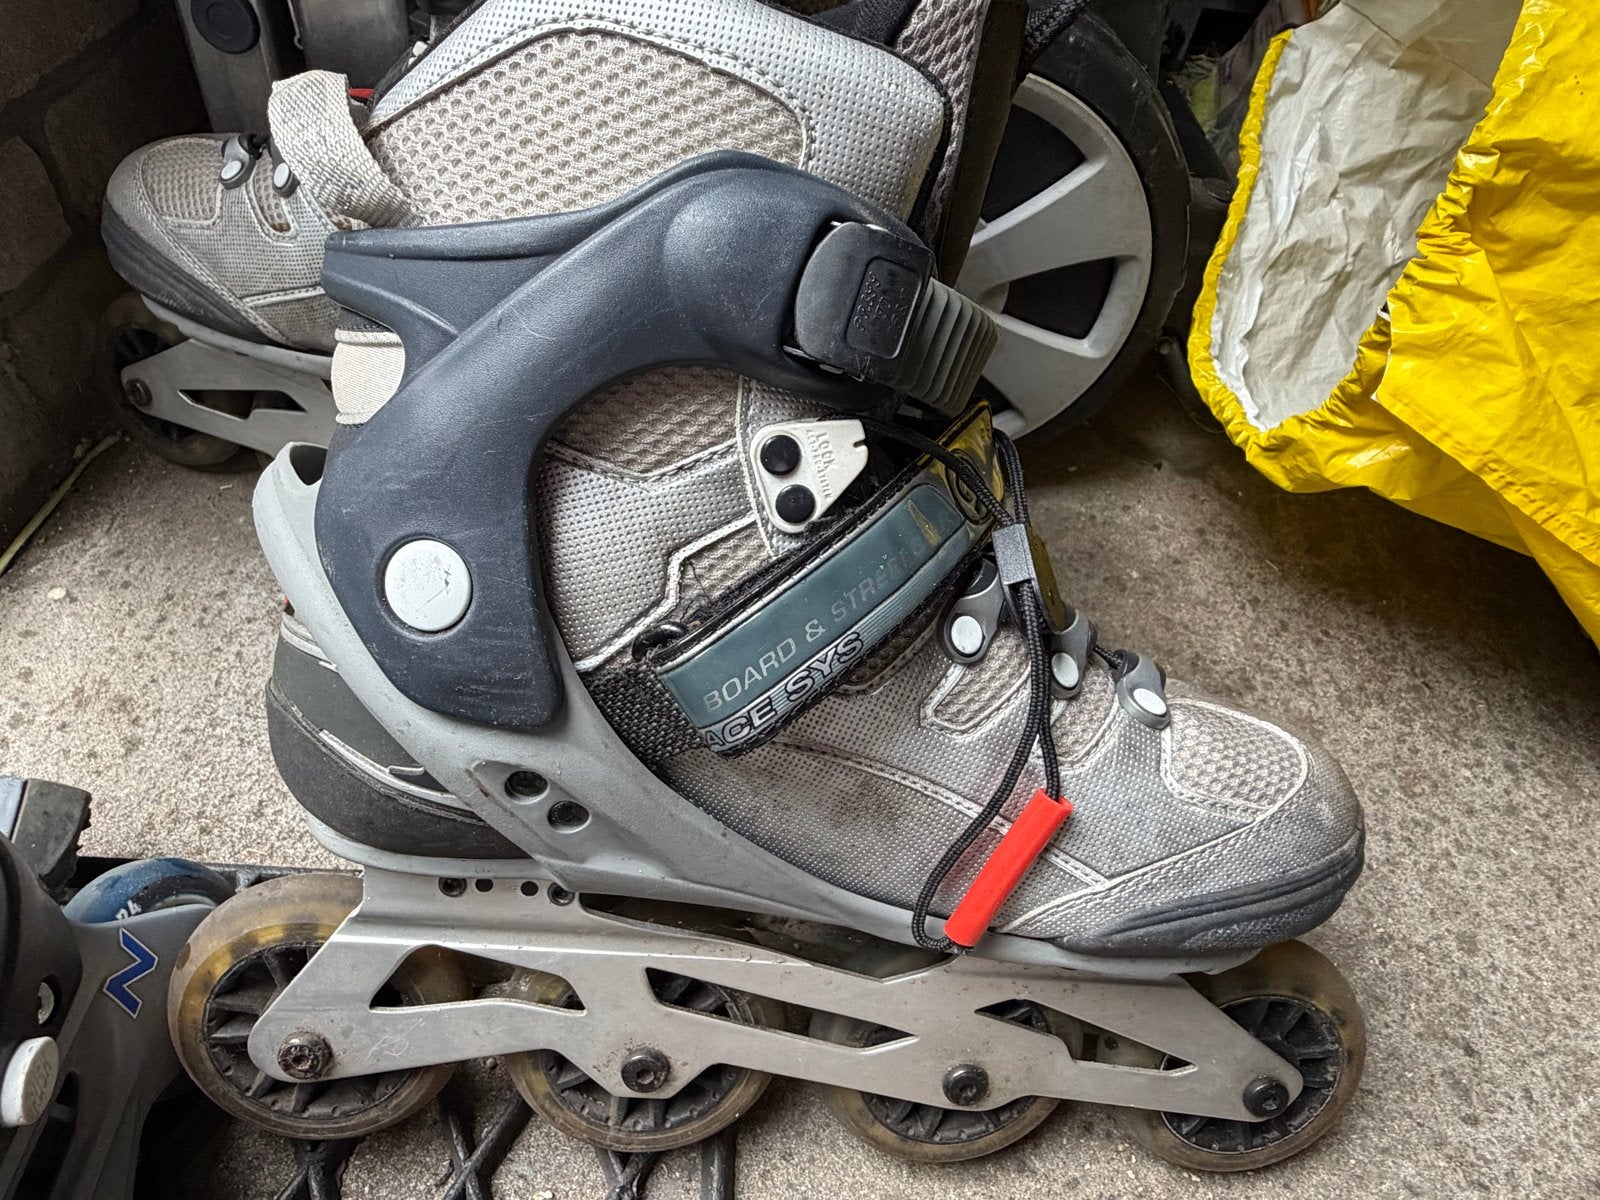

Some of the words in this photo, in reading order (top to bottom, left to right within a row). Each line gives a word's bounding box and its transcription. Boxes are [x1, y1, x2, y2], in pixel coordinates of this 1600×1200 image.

[703, 636, 798, 712] BOARD
[804, 619, 826, 641] &
[784, 631, 863, 702] SYS
